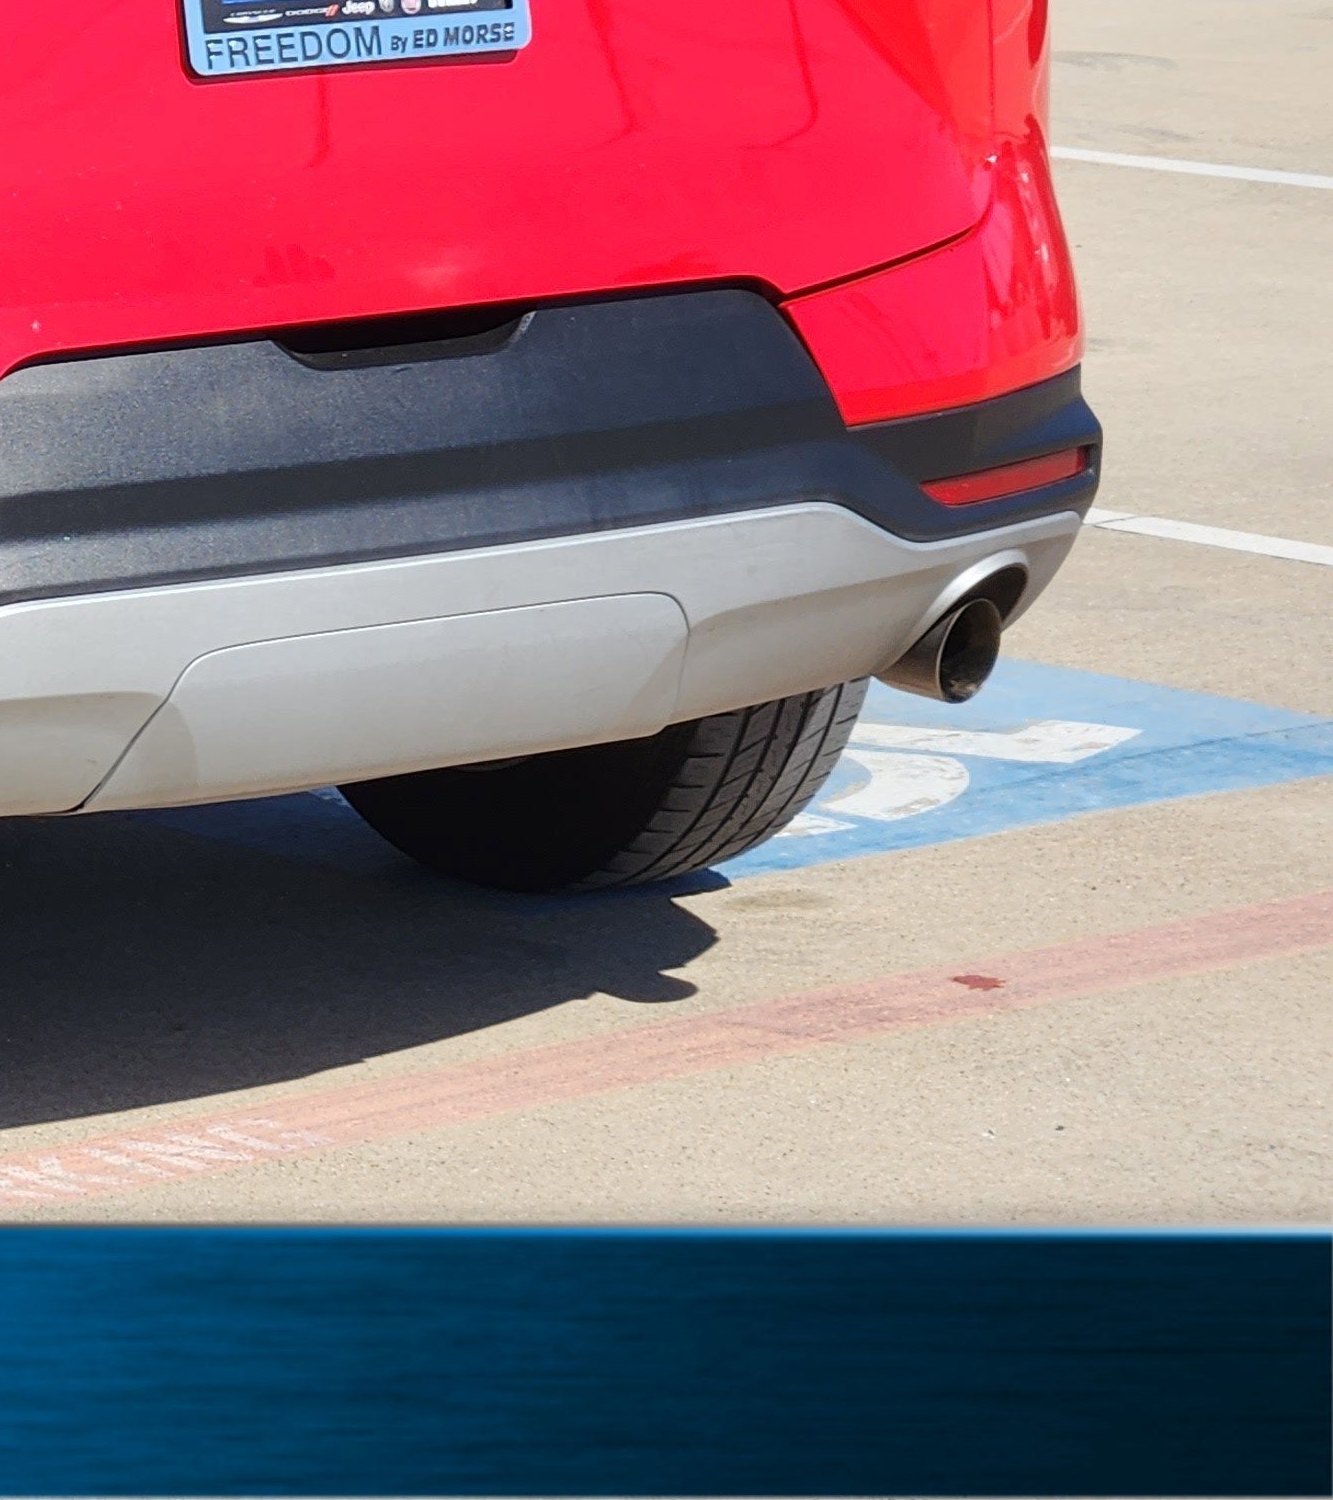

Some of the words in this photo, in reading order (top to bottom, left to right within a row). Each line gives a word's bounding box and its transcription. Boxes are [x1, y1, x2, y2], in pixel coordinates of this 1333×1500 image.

[341, 0, 375, 16] Jeep
[206, 25, 383, 70] FREEDOM
[413, 28, 438, 49] ED
[443, 21, 516, 47] MORSE
